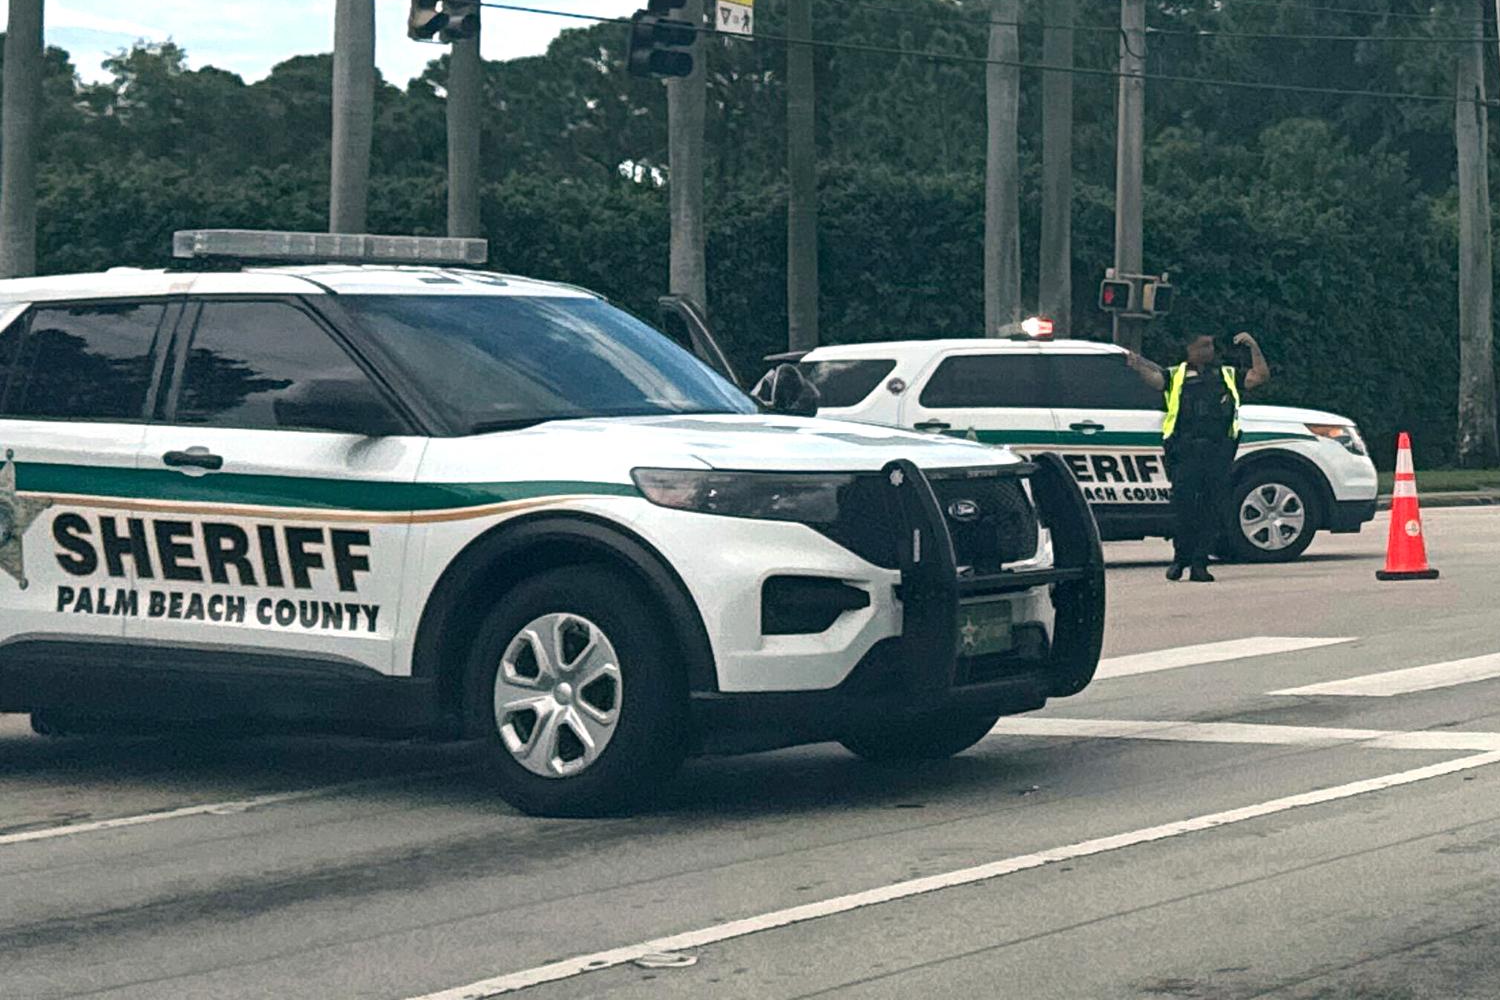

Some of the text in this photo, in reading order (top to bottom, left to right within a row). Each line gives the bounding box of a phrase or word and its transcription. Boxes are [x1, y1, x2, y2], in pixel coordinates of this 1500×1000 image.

[1062, 454, 1168, 483] ERIF
[1083, 486, 1171, 502] ACH COUN
[52, 512, 371, 593] SHERIFF
[56, 585, 381, 633] PALM BEACH COUNTY
